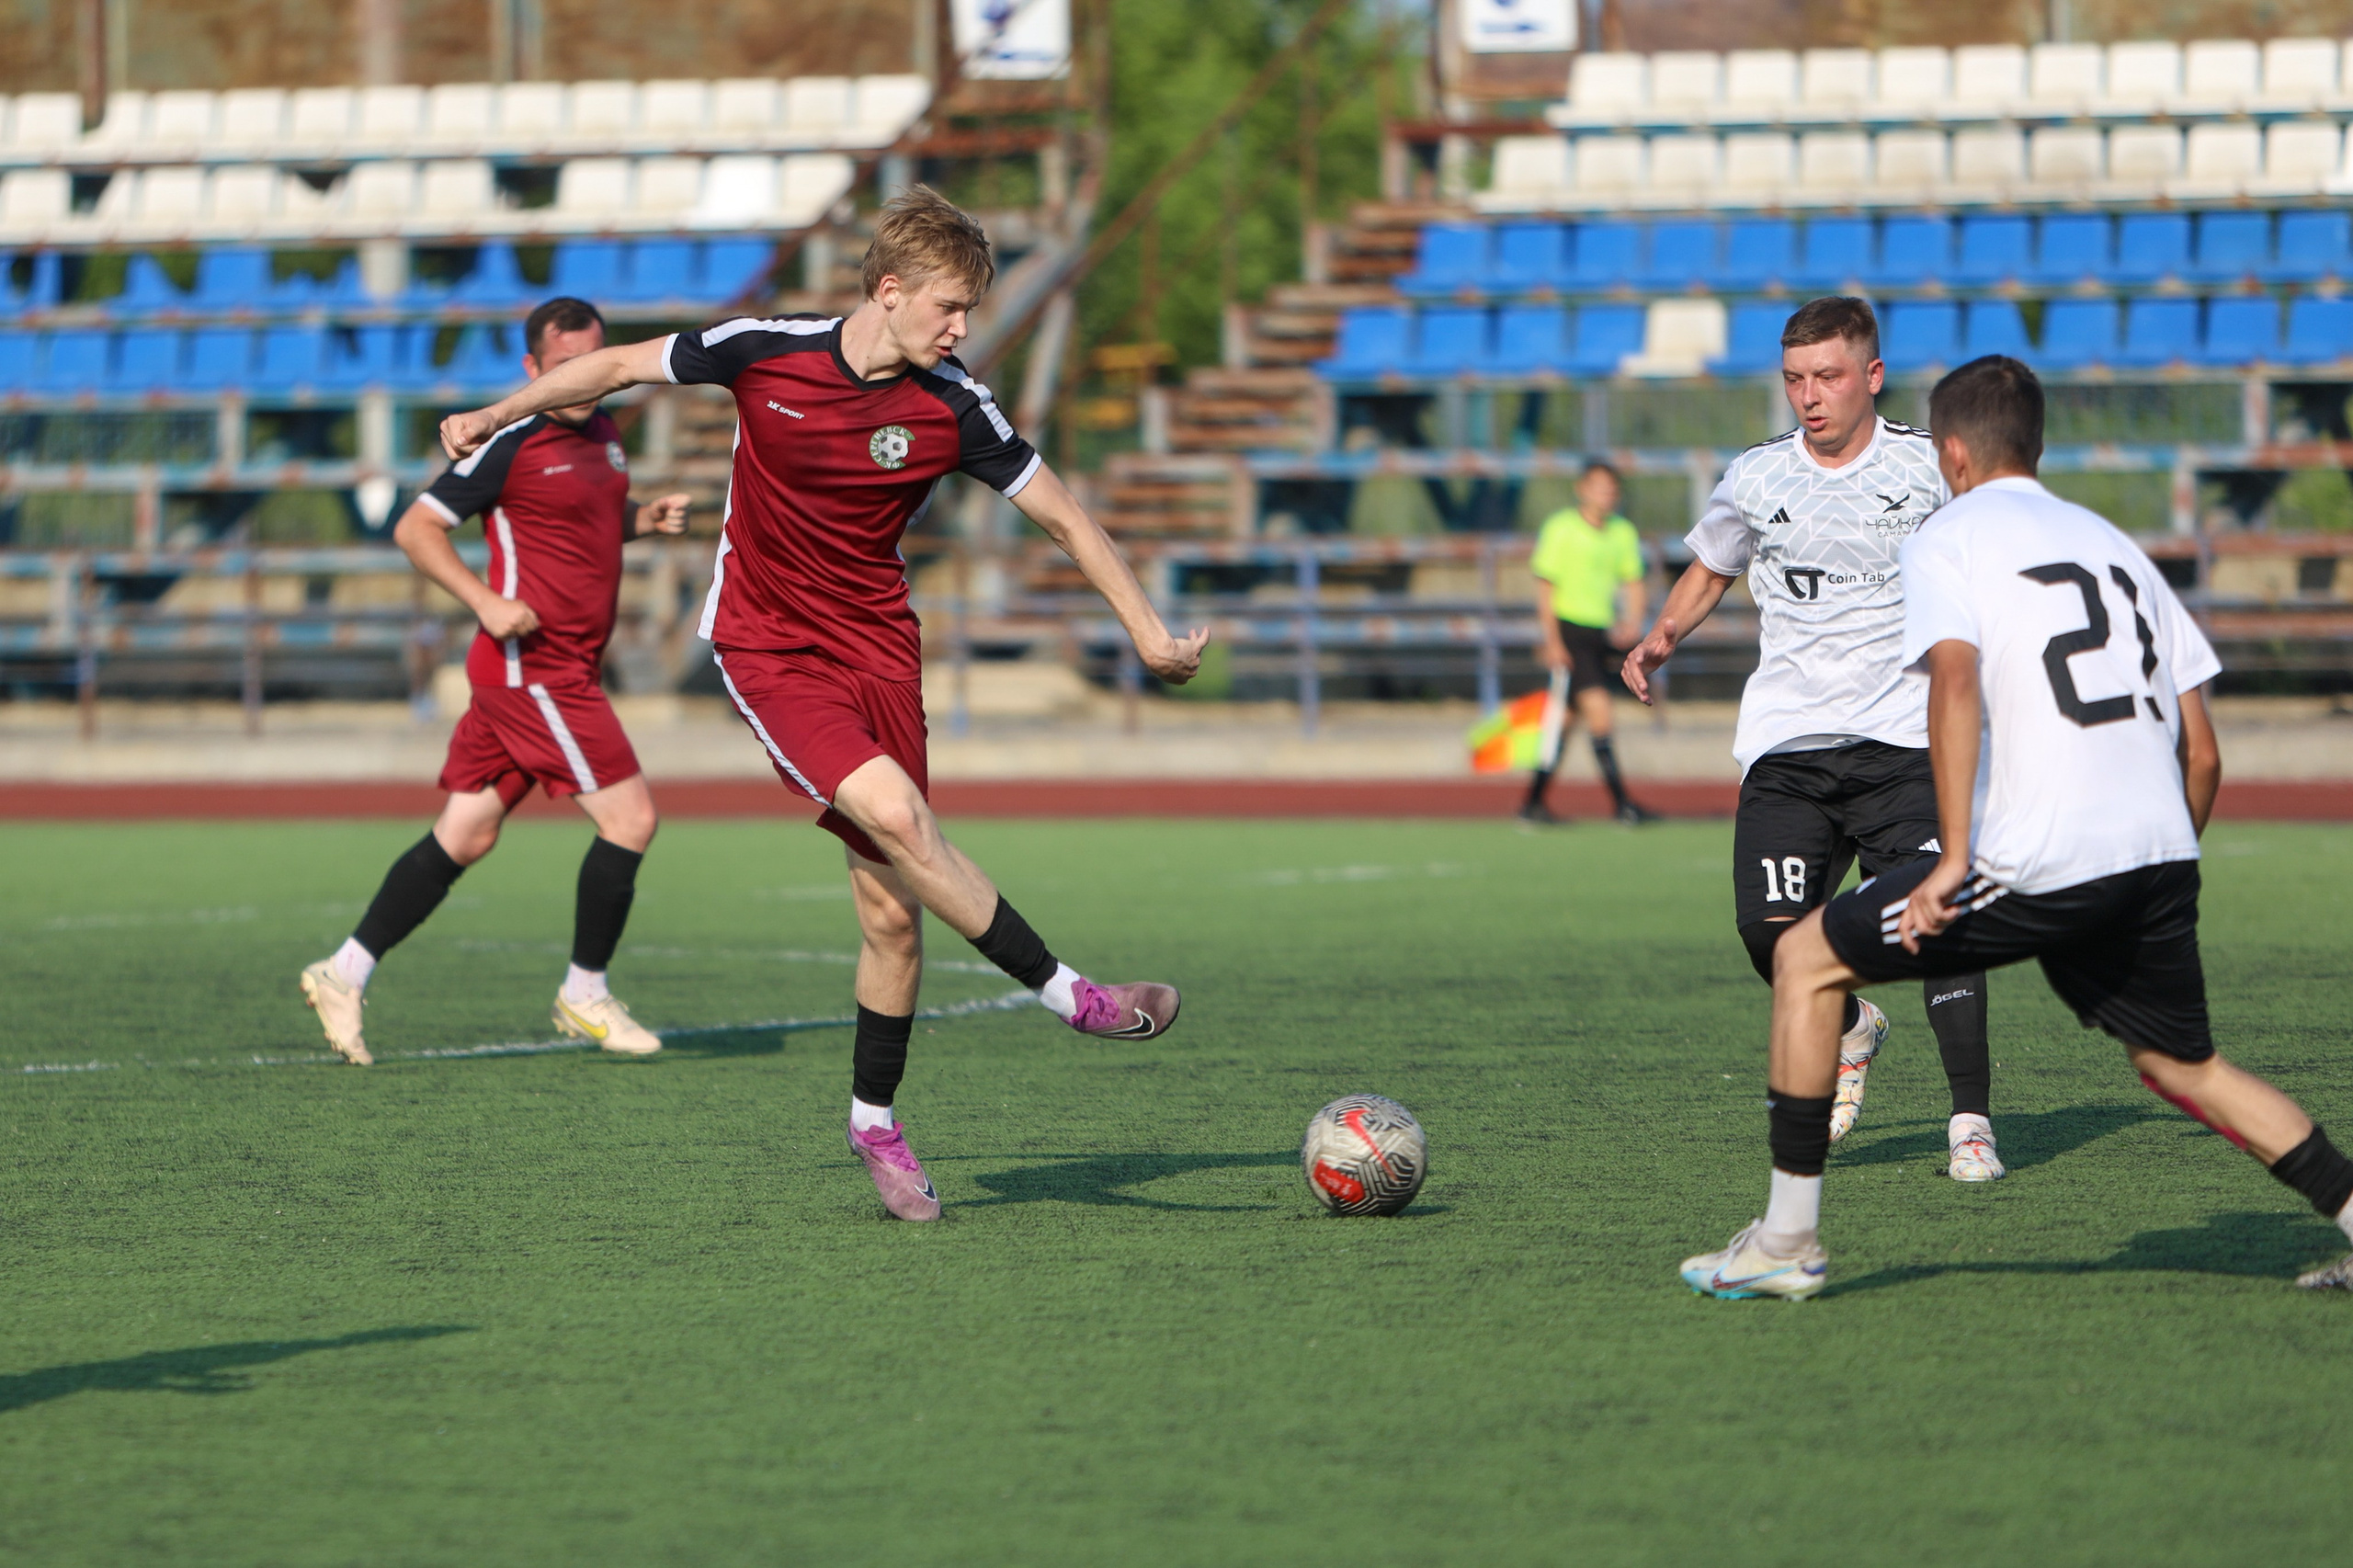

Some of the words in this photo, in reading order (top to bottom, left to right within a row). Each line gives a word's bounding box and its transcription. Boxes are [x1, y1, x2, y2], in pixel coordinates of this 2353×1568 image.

[779, 406, 805, 420] SPORT
[1865, 515, 1922, 530] ЧАЙКА
[1827, 574, 1857, 584] Coin
[1861, 572, 1885, 583] Tab
[2018, 562, 2165, 729] 21
[1761, 857, 1806, 903] 18
[1930, 989, 1974, 1006] JÖGEL
